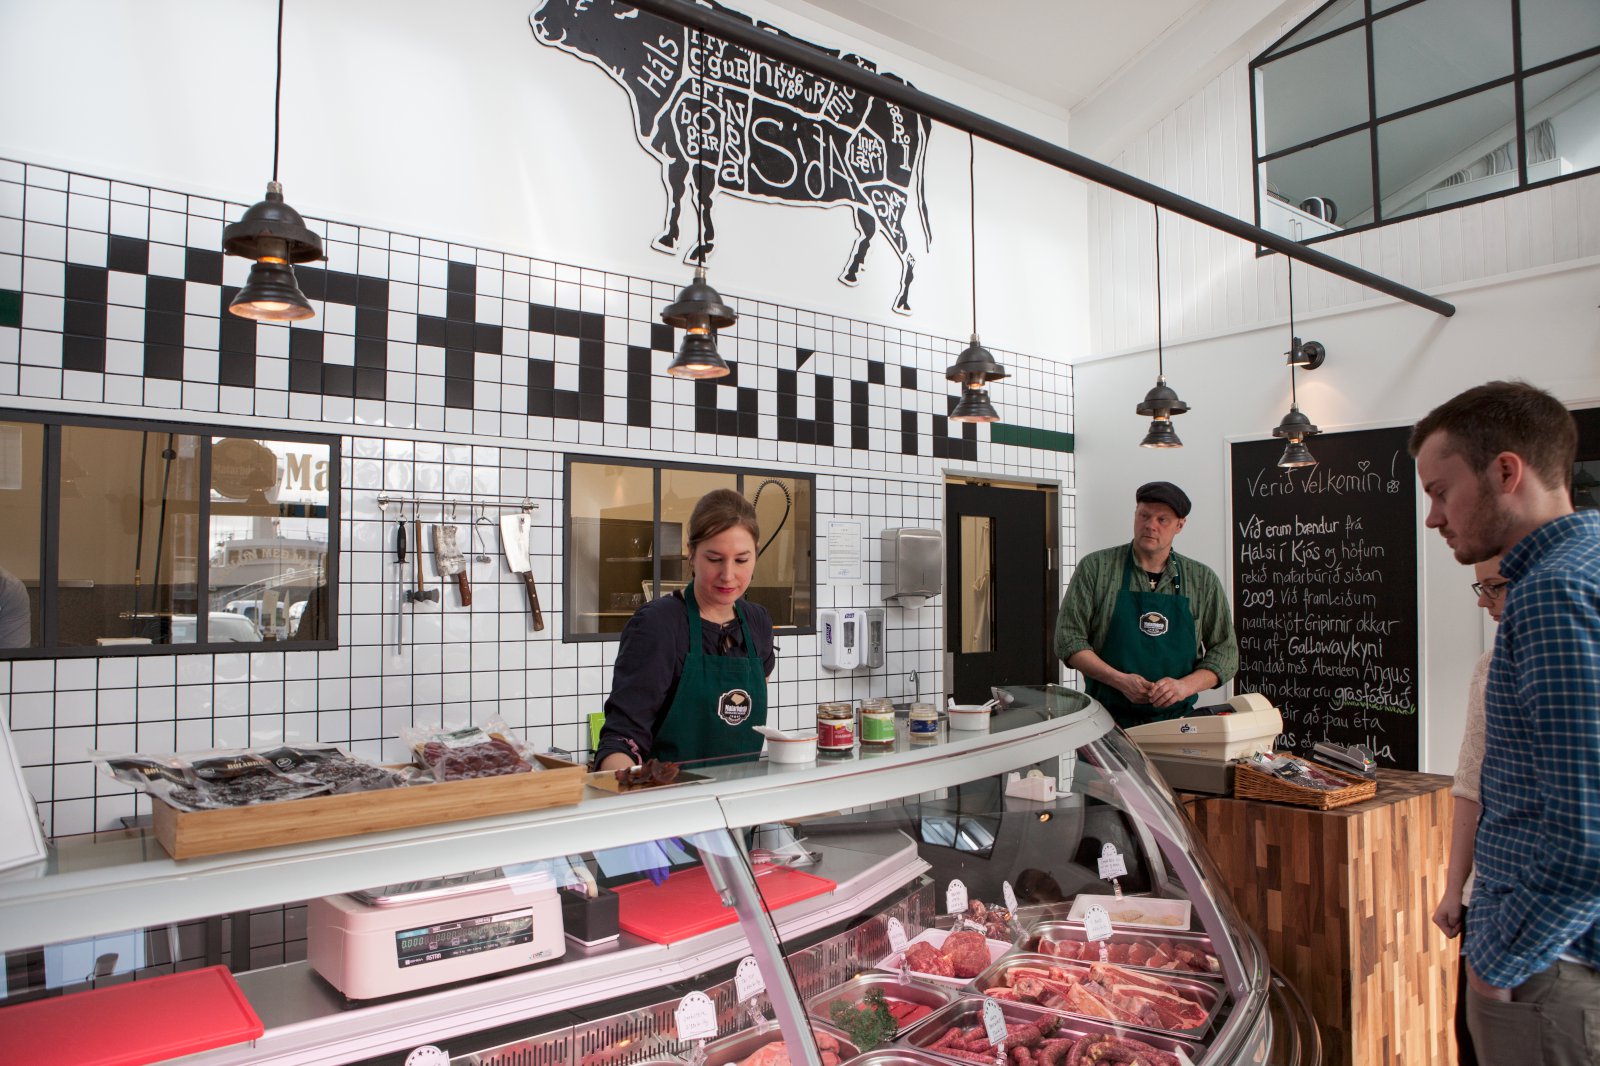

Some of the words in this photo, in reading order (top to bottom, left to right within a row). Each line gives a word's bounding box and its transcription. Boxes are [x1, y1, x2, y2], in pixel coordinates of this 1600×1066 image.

[637, 34, 679, 98] Háls
[1247, 467, 1298, 497] Verið
[1265, 524, 1291, 537] erum
[1295, 514, 1340, 536] bændur
[1345, 514, 1364, 539] frá
[1241, 542, 1276, 564] Hálsi
[1291, 540, 1320, 567] Kjós
[1324, 547, 1337, 568] og
[1341, 538, 1385, 561] höfum
[1241, 563, 1267, 584] rekið
[1280, 585, 1298, 605] Við
[1303, 587, 1376, 613] framleiðum
[1356, 611, 1400, 636] okkar
[1240, 636, 1260, 651] eru
[1264, 632, 1280, 658] af
[1288, 634, 1383, 666] Gallowaykyni
[1240, 650, 1284, 674] blandað
[1287, 657, 1308, 674] með
[1311, 656, 1359, 679] Aberdeen
[1279, 677, 1311, 698] okkar
[1313, 686, 1331, 697] eru
[1303, 704, 1320, 725] að
[1321, 710, 1349, 733] þau
[1353, 709, 1387, 732] éta
